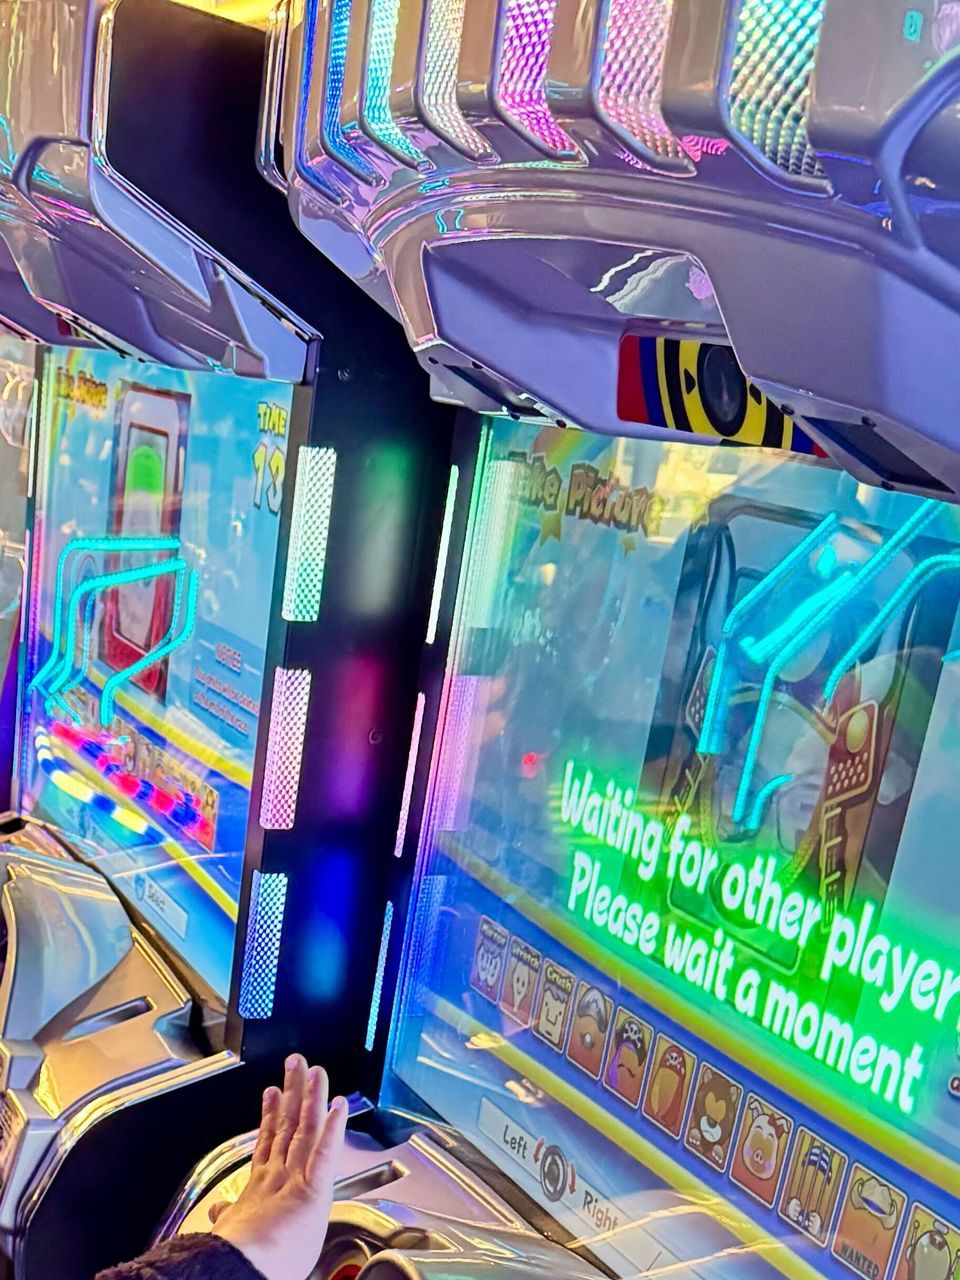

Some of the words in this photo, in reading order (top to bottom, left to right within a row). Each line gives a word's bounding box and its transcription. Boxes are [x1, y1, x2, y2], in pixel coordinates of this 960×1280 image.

[257, 401, 287, 436] TIME
[561, 760, 663, 881] Waiting
[666, 814, 717, 894] for
[721, 855, 822, 948] other
[821, 901, 960, 1032] player
[546, 965, 574, 993] Crush
[568, 851, 660, 955] Please
[664, 923, 735, 999] wait
[735, 969, 761, 1018] a
[762, 984, 924, 1115] moment
[503, 1124, 528, 1160] Left
[582, 1190, 619, 1232] Right
[840, 1241, 879, 1279] WANTED
